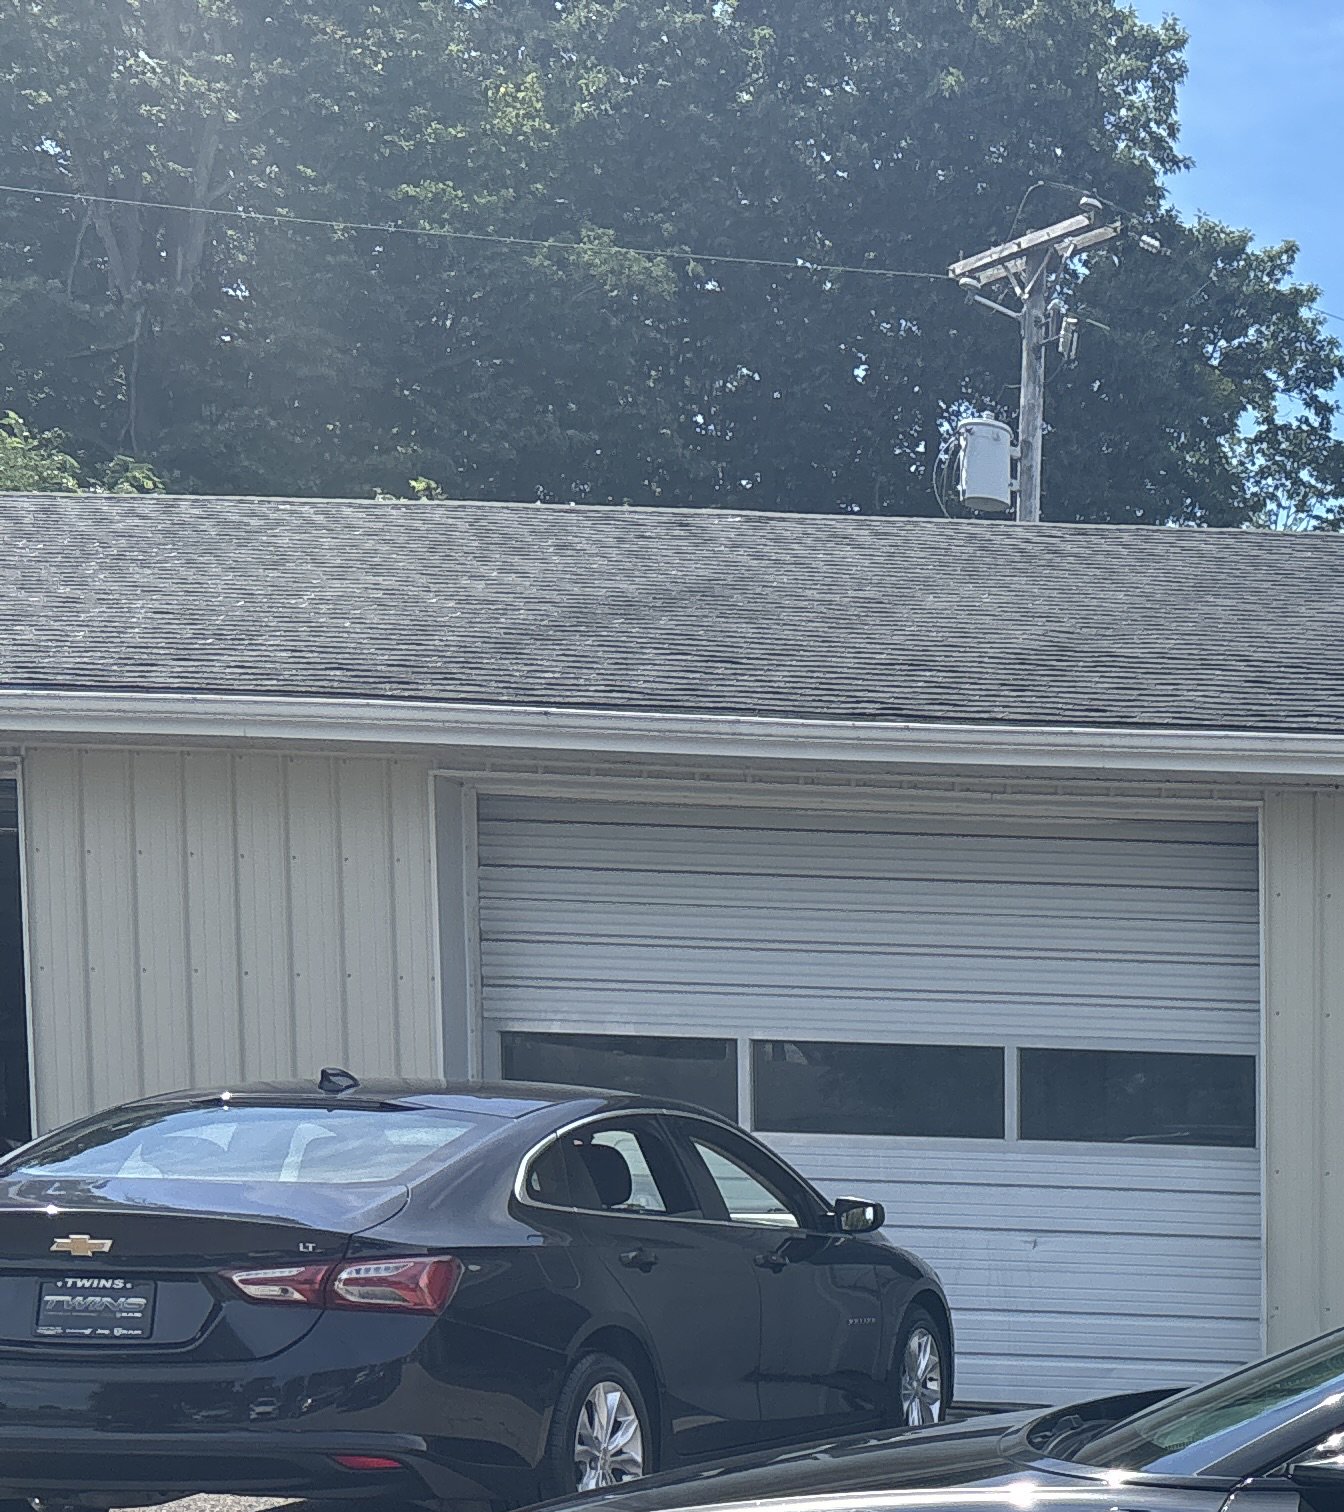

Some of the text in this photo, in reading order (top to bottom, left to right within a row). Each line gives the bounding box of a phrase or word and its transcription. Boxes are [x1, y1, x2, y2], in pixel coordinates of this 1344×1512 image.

[299, 1242, 316, 1252] LT
[64, 1278, 125, 1289] TWINS
[43, 1295, 147, 1311] TWINS
